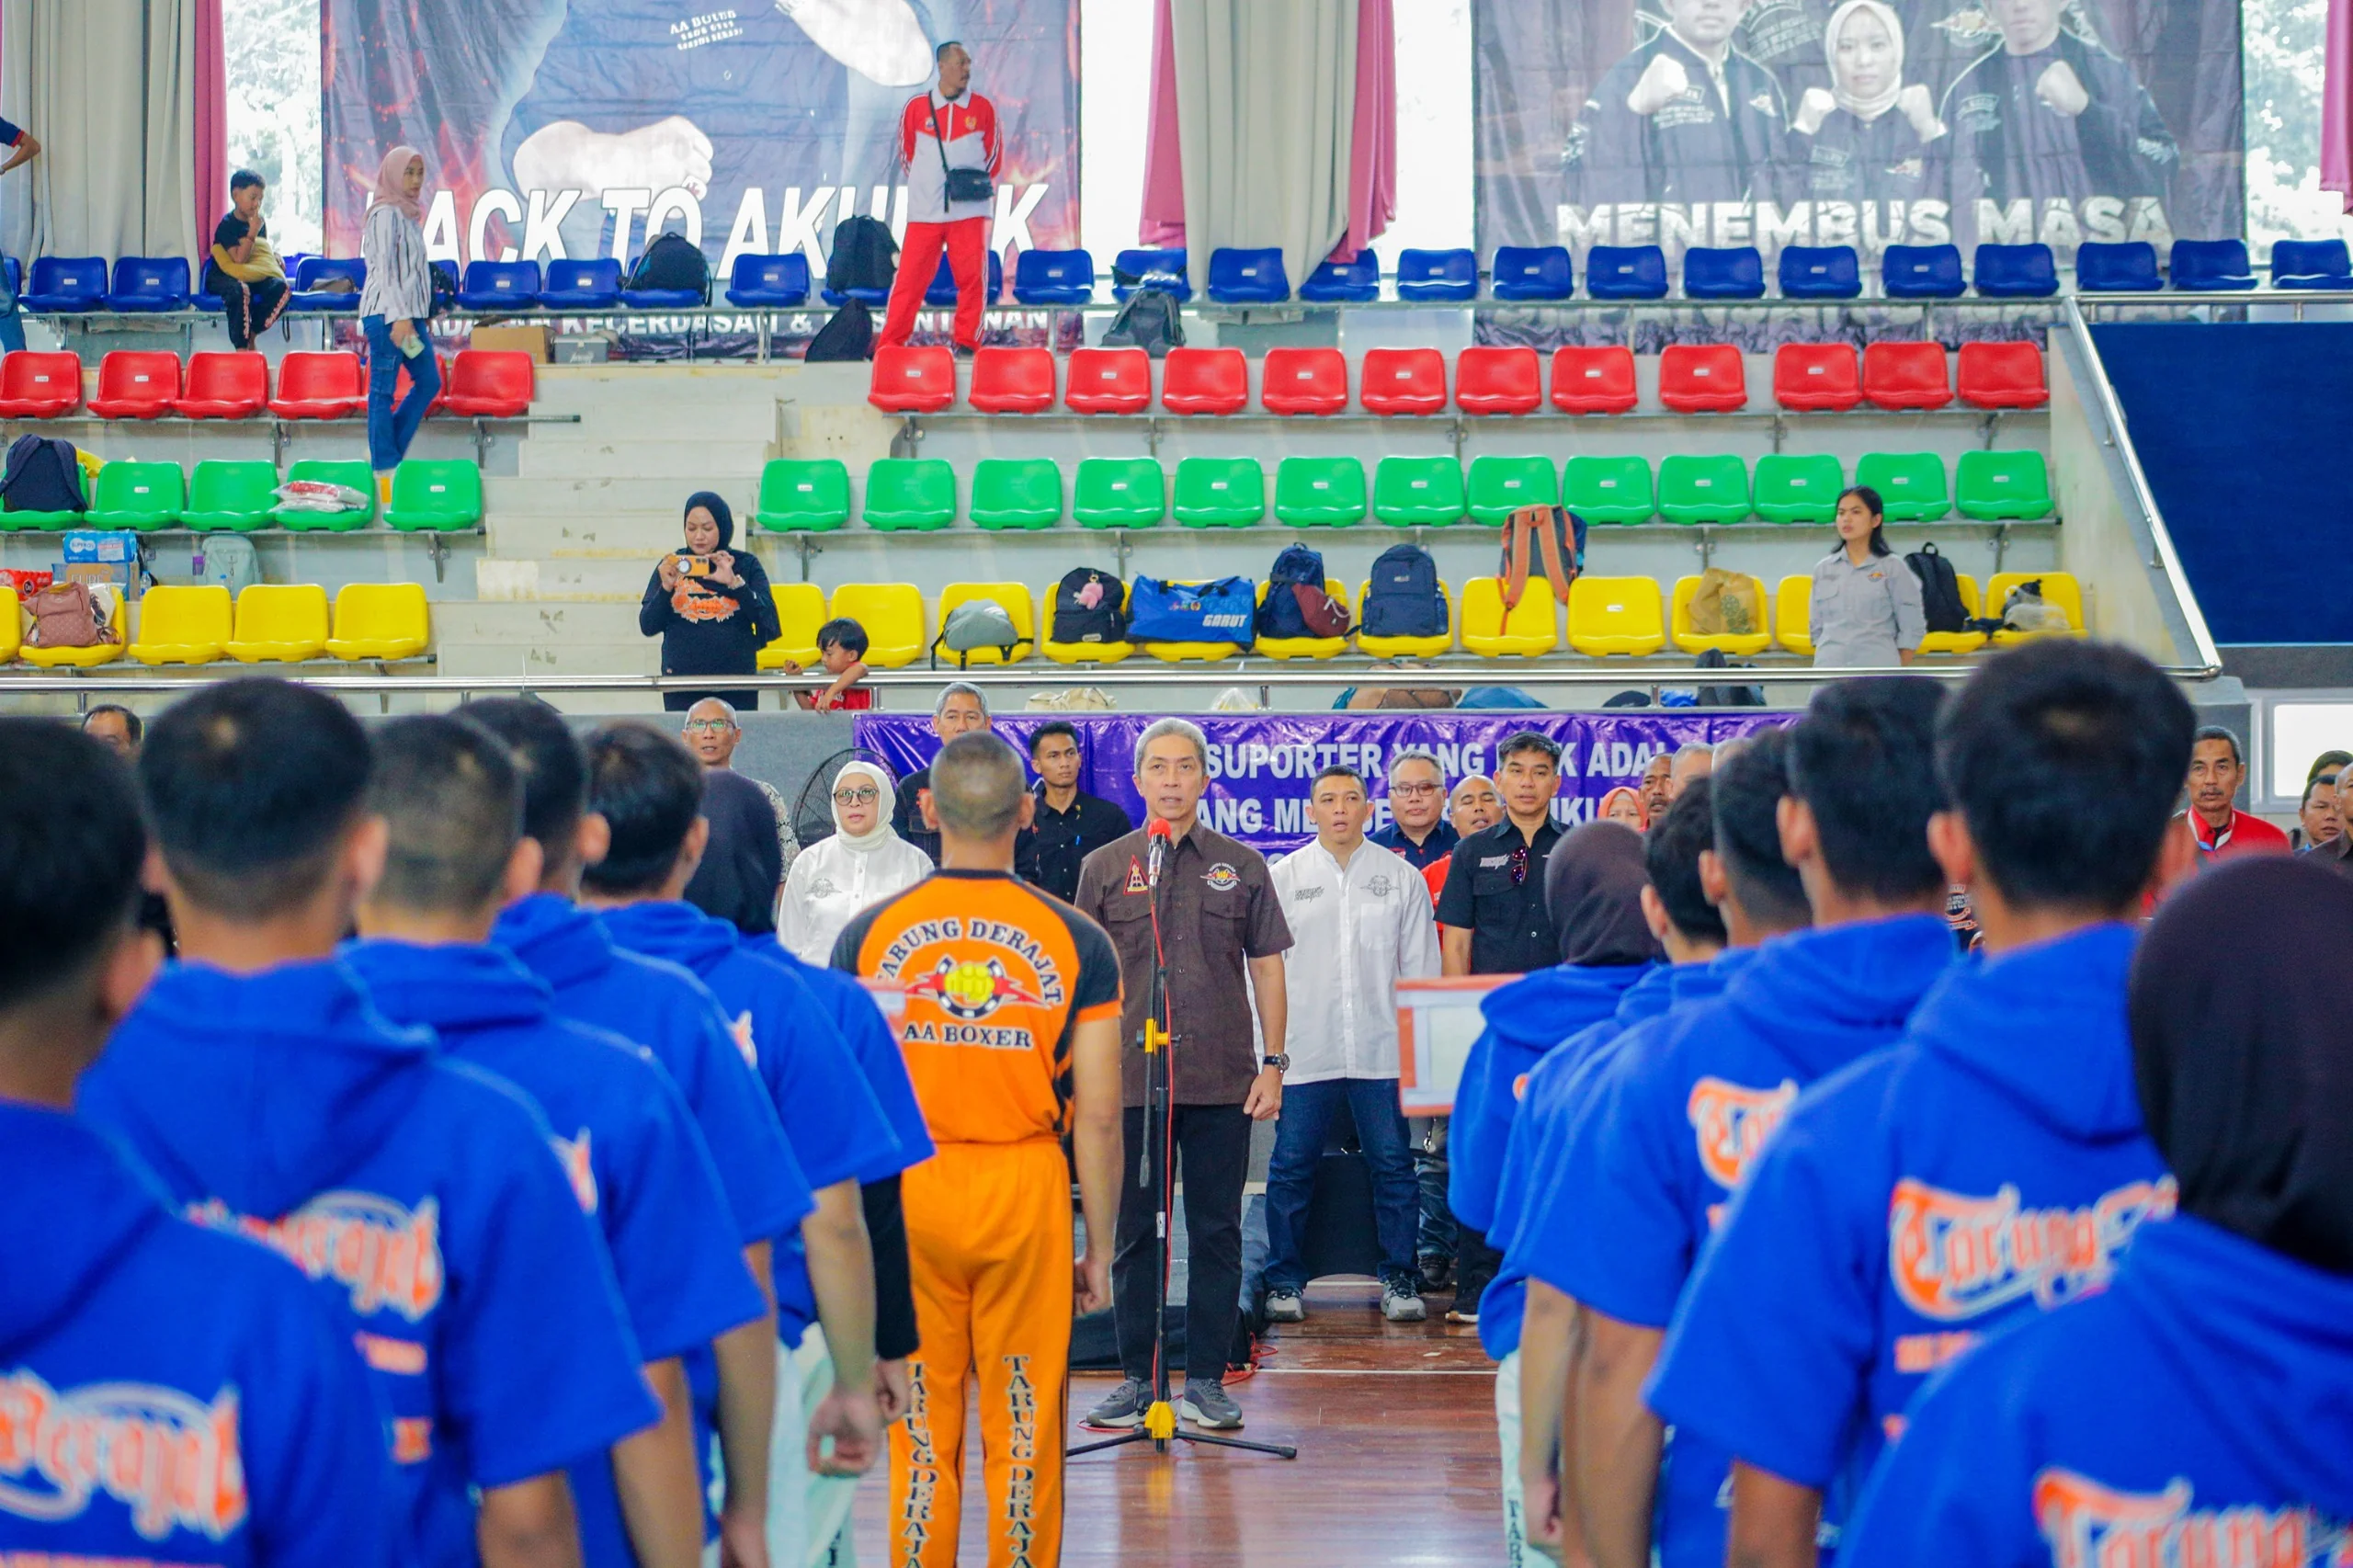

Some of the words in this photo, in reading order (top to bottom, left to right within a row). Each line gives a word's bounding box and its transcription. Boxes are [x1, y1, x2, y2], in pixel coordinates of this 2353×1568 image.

[360, 187, 582, 279] ACK
[600, 187, 703, 278] TO
[1557, 199, 1951, 256] MENEMBUS
[1977, 195, 2176, 251] MASA
[1205, 743, 1383, 779] SUPORTER
[1197, 798, 1263, 834] ANG
[968, 917, 1066, 1006] DERAJAT
[904, 1023, 937, 1043] AA
[943, 1023, 1035, 1050] BOXER
[1003, 1354, 1038, 1461] TARUNG
[1508, 1499, 1524, 1568] TAR
